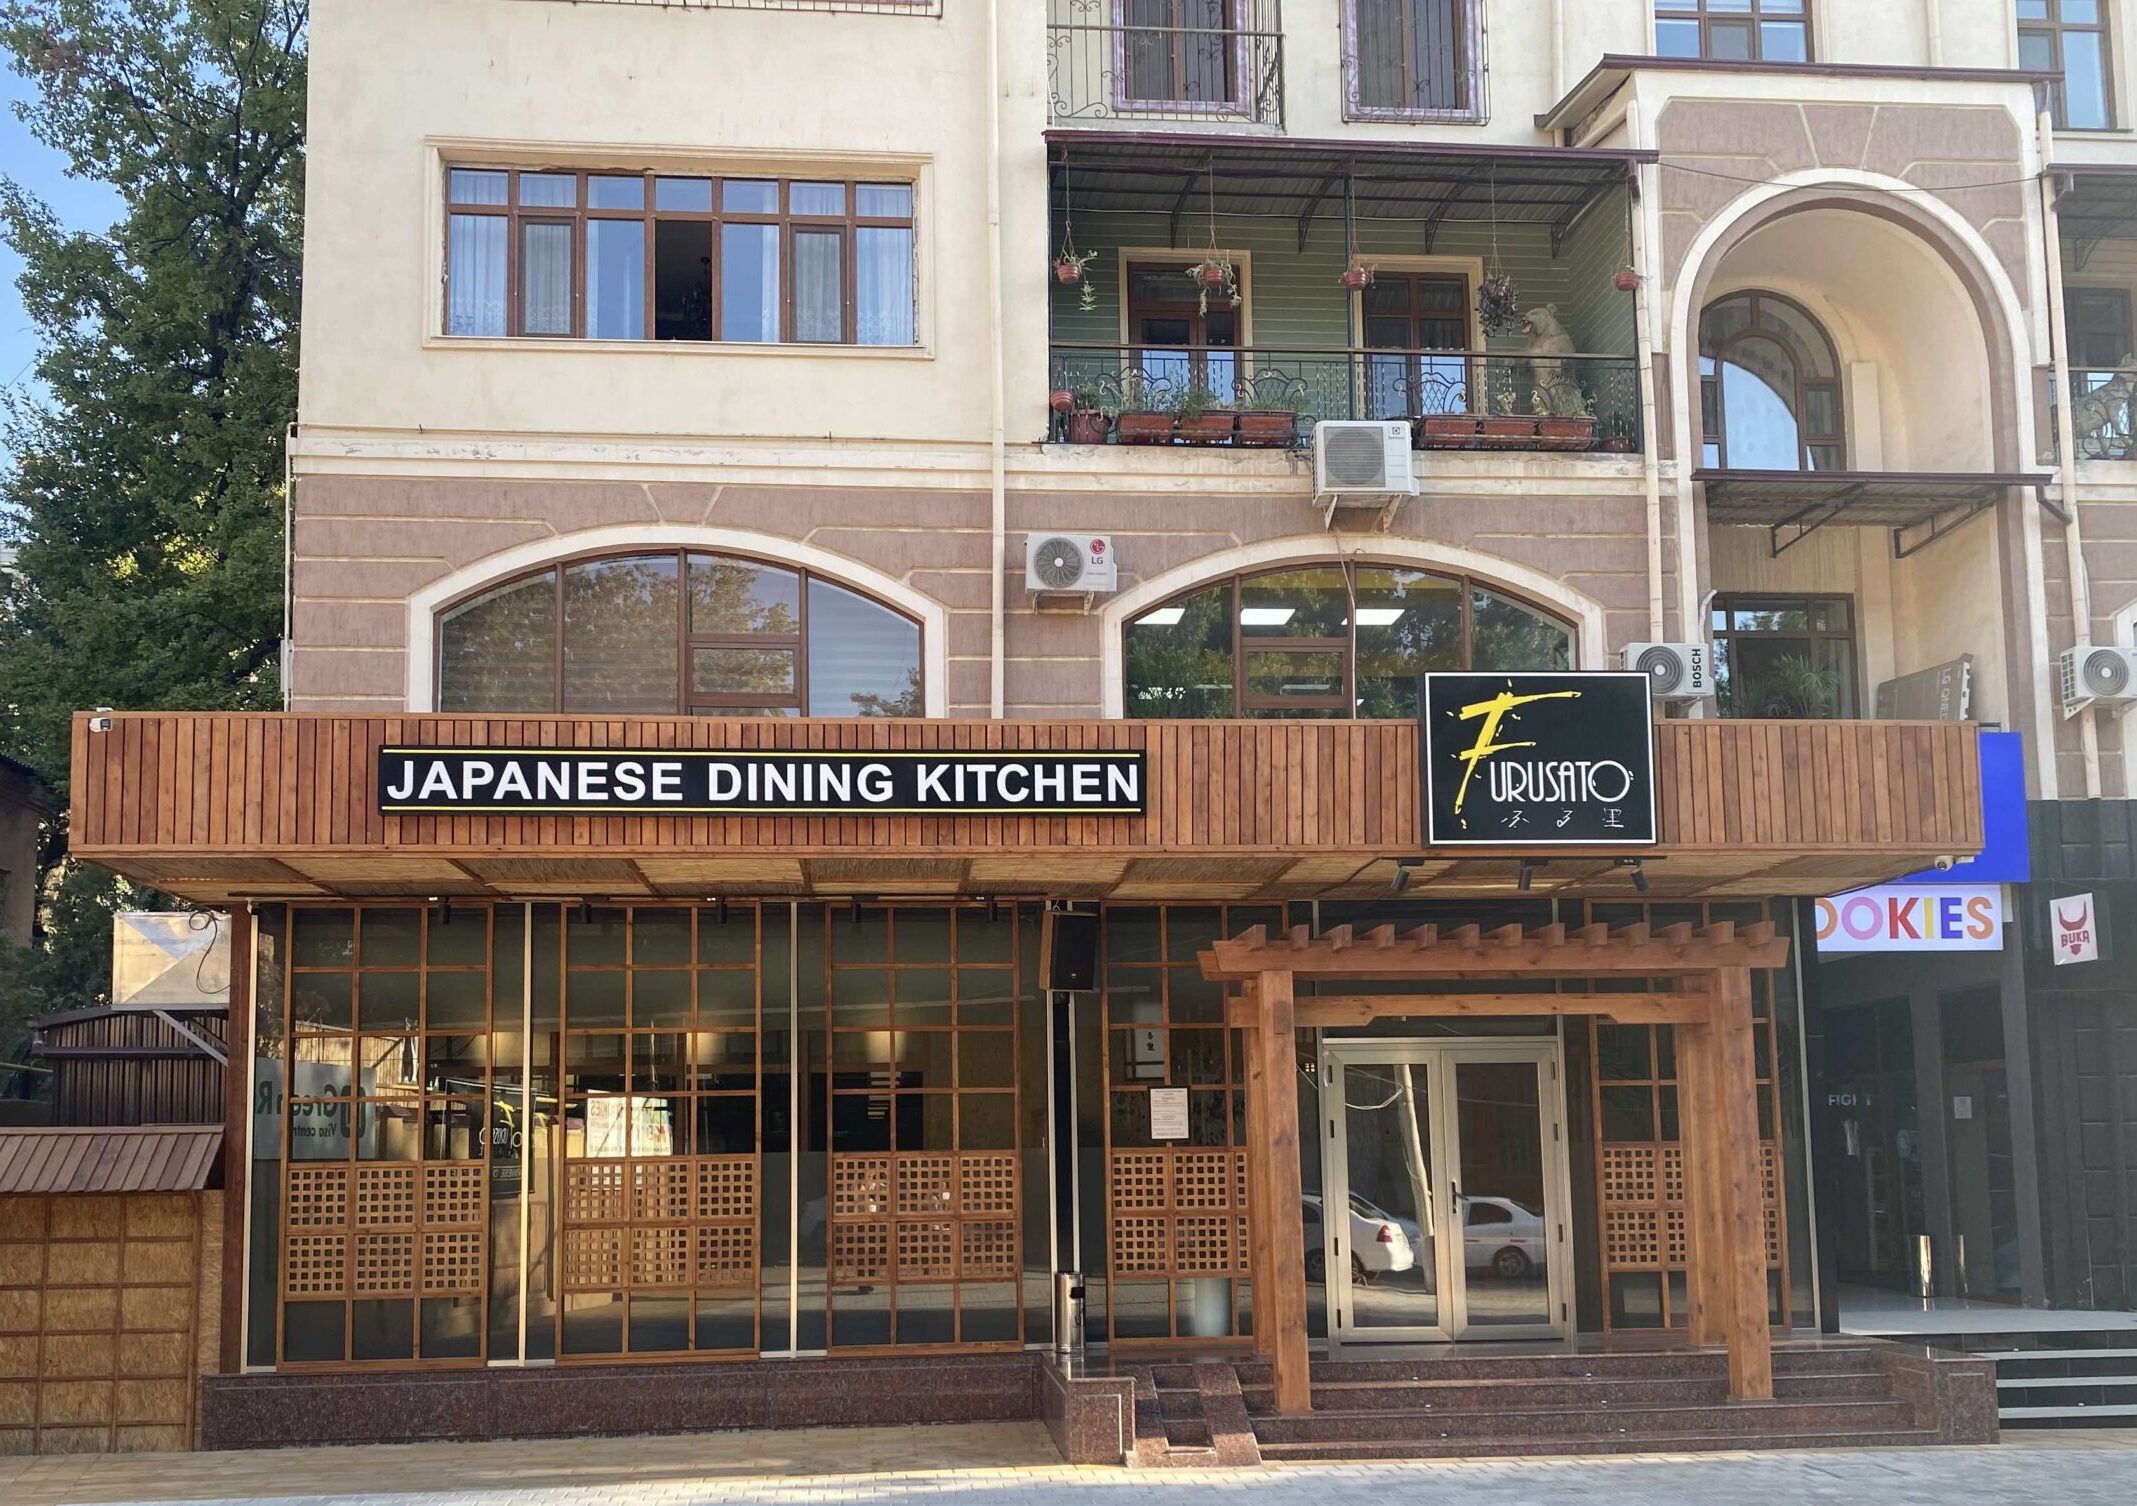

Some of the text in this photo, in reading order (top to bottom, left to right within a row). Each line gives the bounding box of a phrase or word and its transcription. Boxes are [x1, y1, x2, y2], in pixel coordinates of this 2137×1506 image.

[1091, 557, 1104, 565] LG
[1691, 648, 1702, 688] BOSCH
[386, 760, 1138, 803] JAPANESE DINING KITCHEN
[2060, 930, 2090, 948] BUKA
